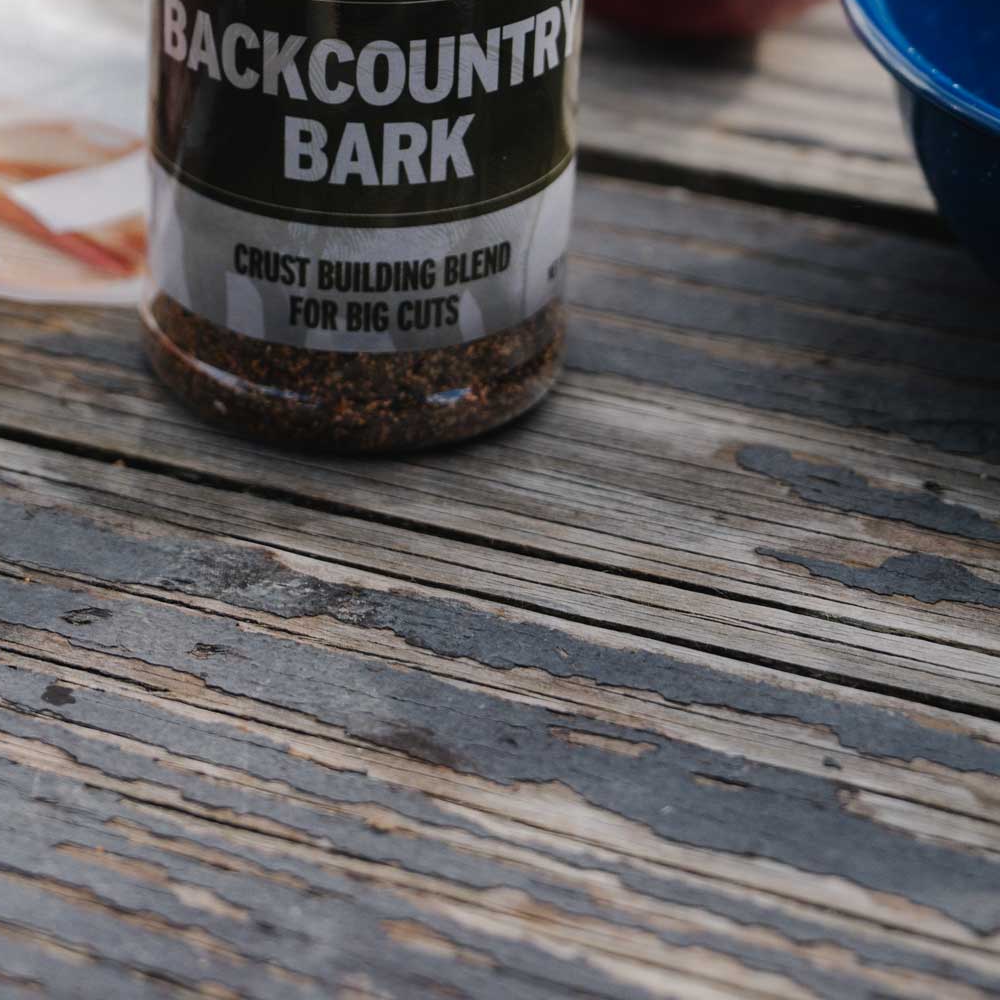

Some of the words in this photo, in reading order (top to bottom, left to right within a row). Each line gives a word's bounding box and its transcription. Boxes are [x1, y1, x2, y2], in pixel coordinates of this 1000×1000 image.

[283, 113, 476, 186] BARK
[234, 242, 311, 288] CRUST
[317, 258, 436, 293] BUILDING
[443, 240, 512, 288] BLEND
[288, 295, 338, 331] FOR
[345, 300, 389, 333] BIG
[395, 294, 460, 331] CUTS
